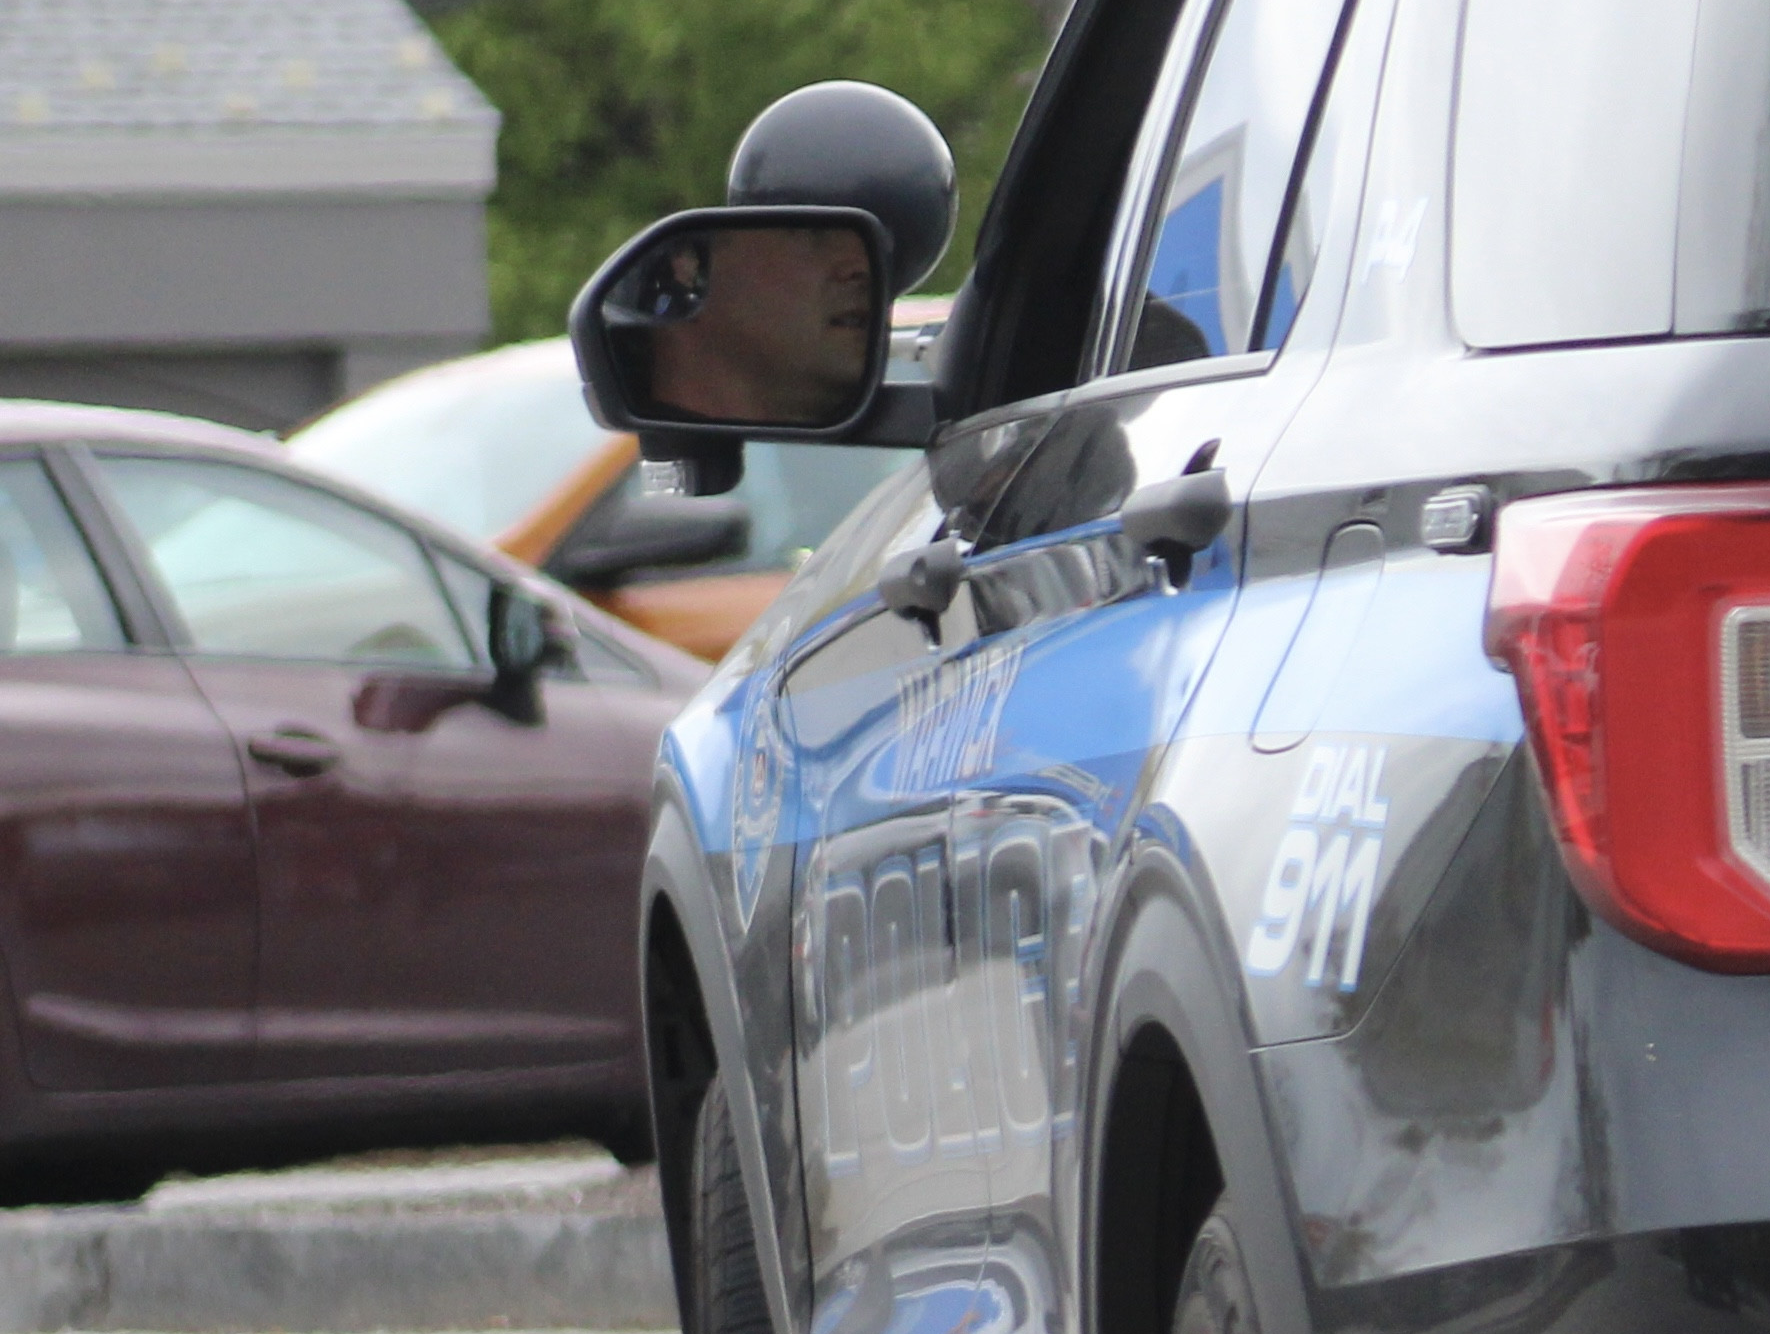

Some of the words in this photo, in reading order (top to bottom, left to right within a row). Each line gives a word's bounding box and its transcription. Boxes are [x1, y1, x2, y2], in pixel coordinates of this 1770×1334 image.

[1290, 741, 1390, 829] DIAL
[1246, 821, 1383, 993] 911
[824, 820, 1092, 1179] POLICE
